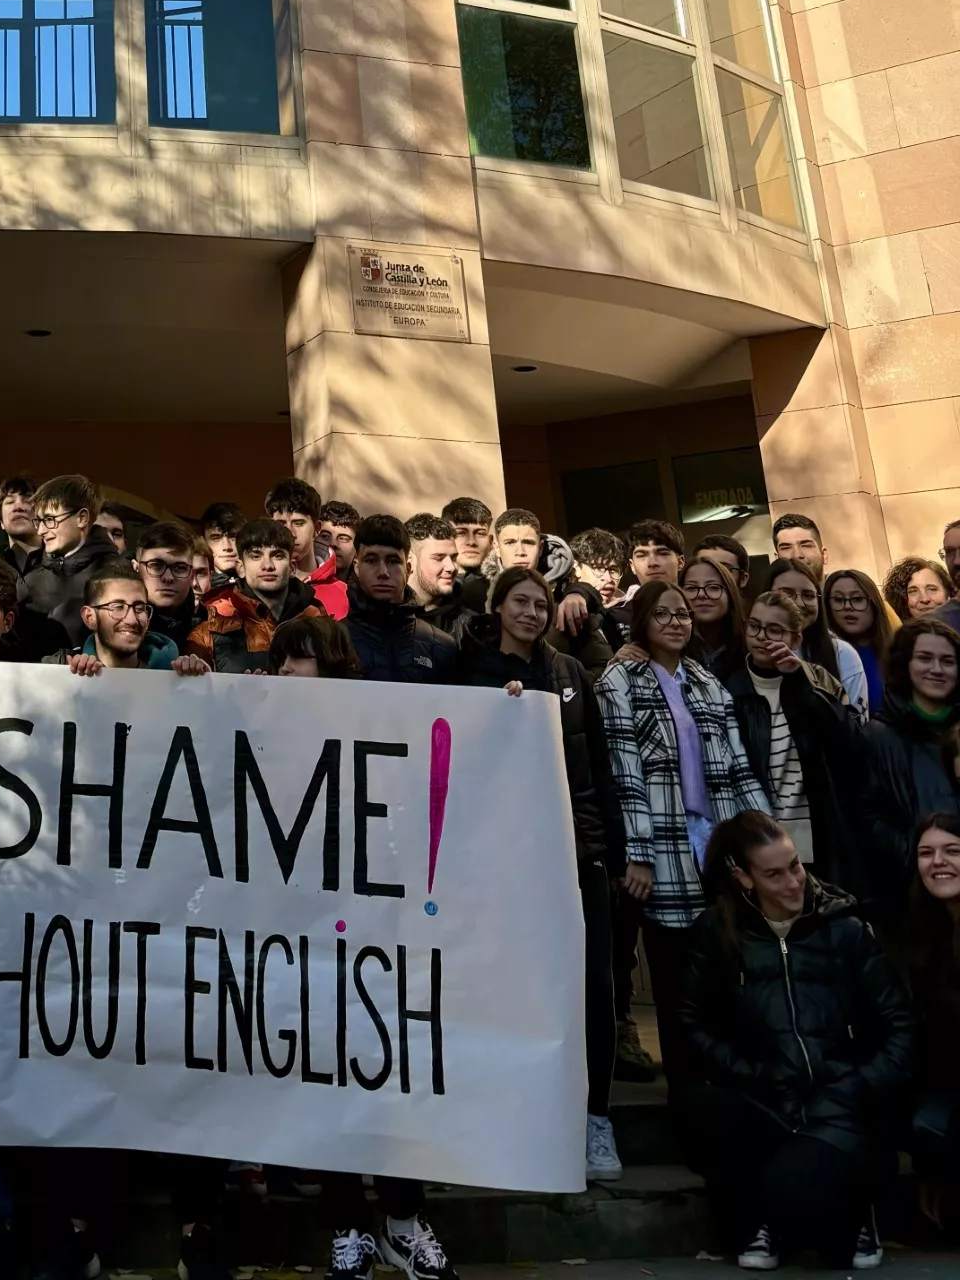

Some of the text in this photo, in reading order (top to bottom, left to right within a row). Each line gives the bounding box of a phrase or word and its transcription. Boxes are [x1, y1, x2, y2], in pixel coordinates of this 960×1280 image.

[385, 262, 424, 273] Junta de
[385, 272, 448, 287] Castilla y León
[356, 299, 383, 308] INSTITUTO
[384, 301, 392, 309] DE
[426, 305, 460, 315] SECUNDARIA
[695, 486, 755, 509] ENTRADA
